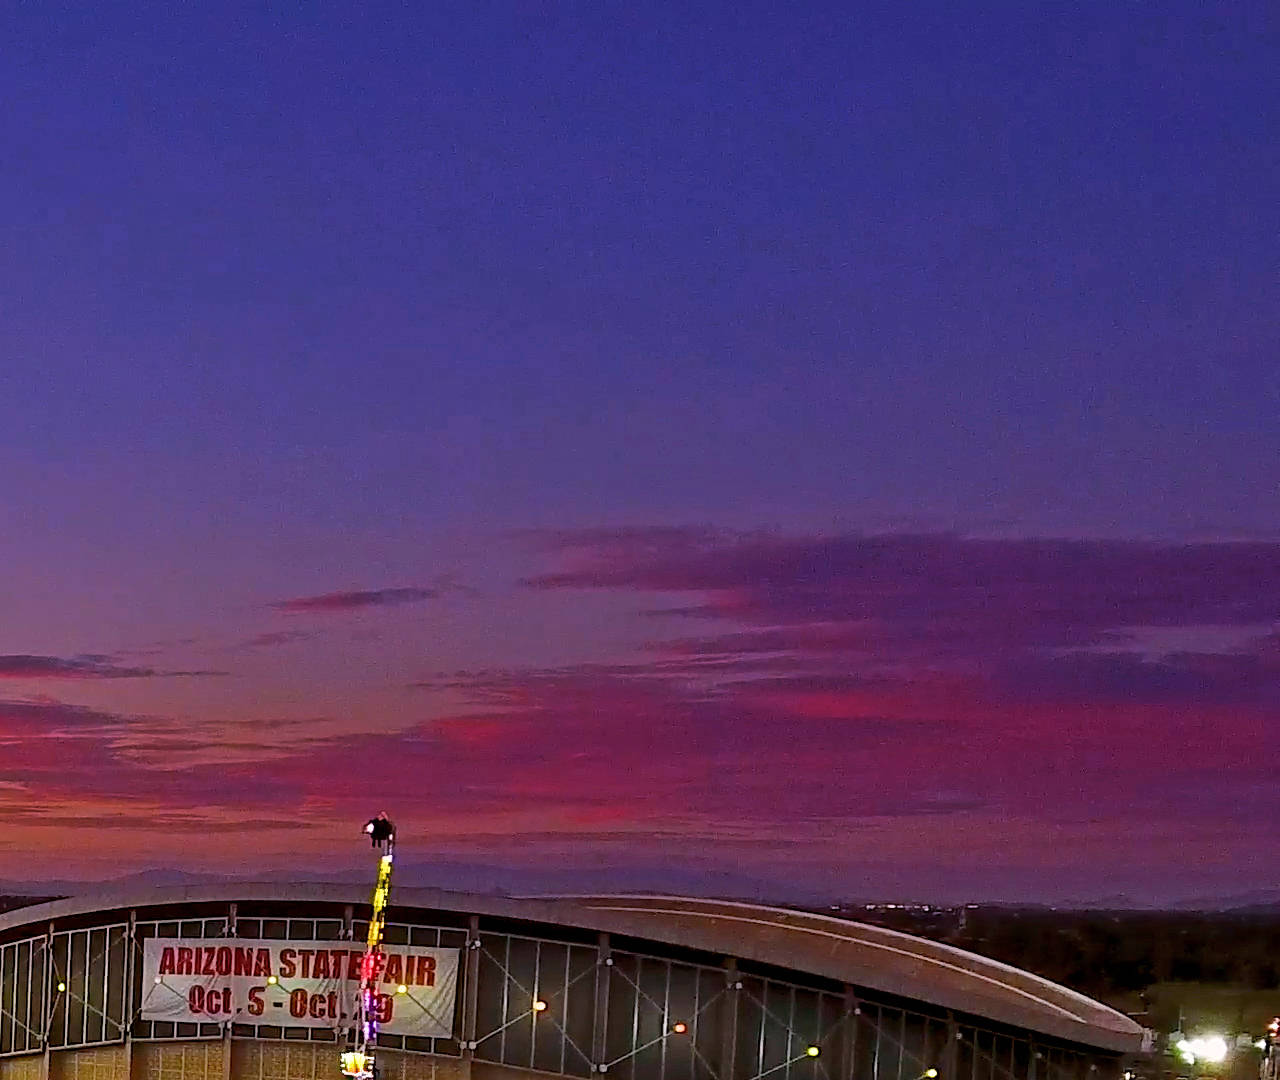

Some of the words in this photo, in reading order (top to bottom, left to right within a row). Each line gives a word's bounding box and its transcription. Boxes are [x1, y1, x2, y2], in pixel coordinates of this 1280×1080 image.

[158, 946, 272, 978] ARIZONA
[279, 947, 364, 981] STATE
[247, 986, 266, 1017] 5
